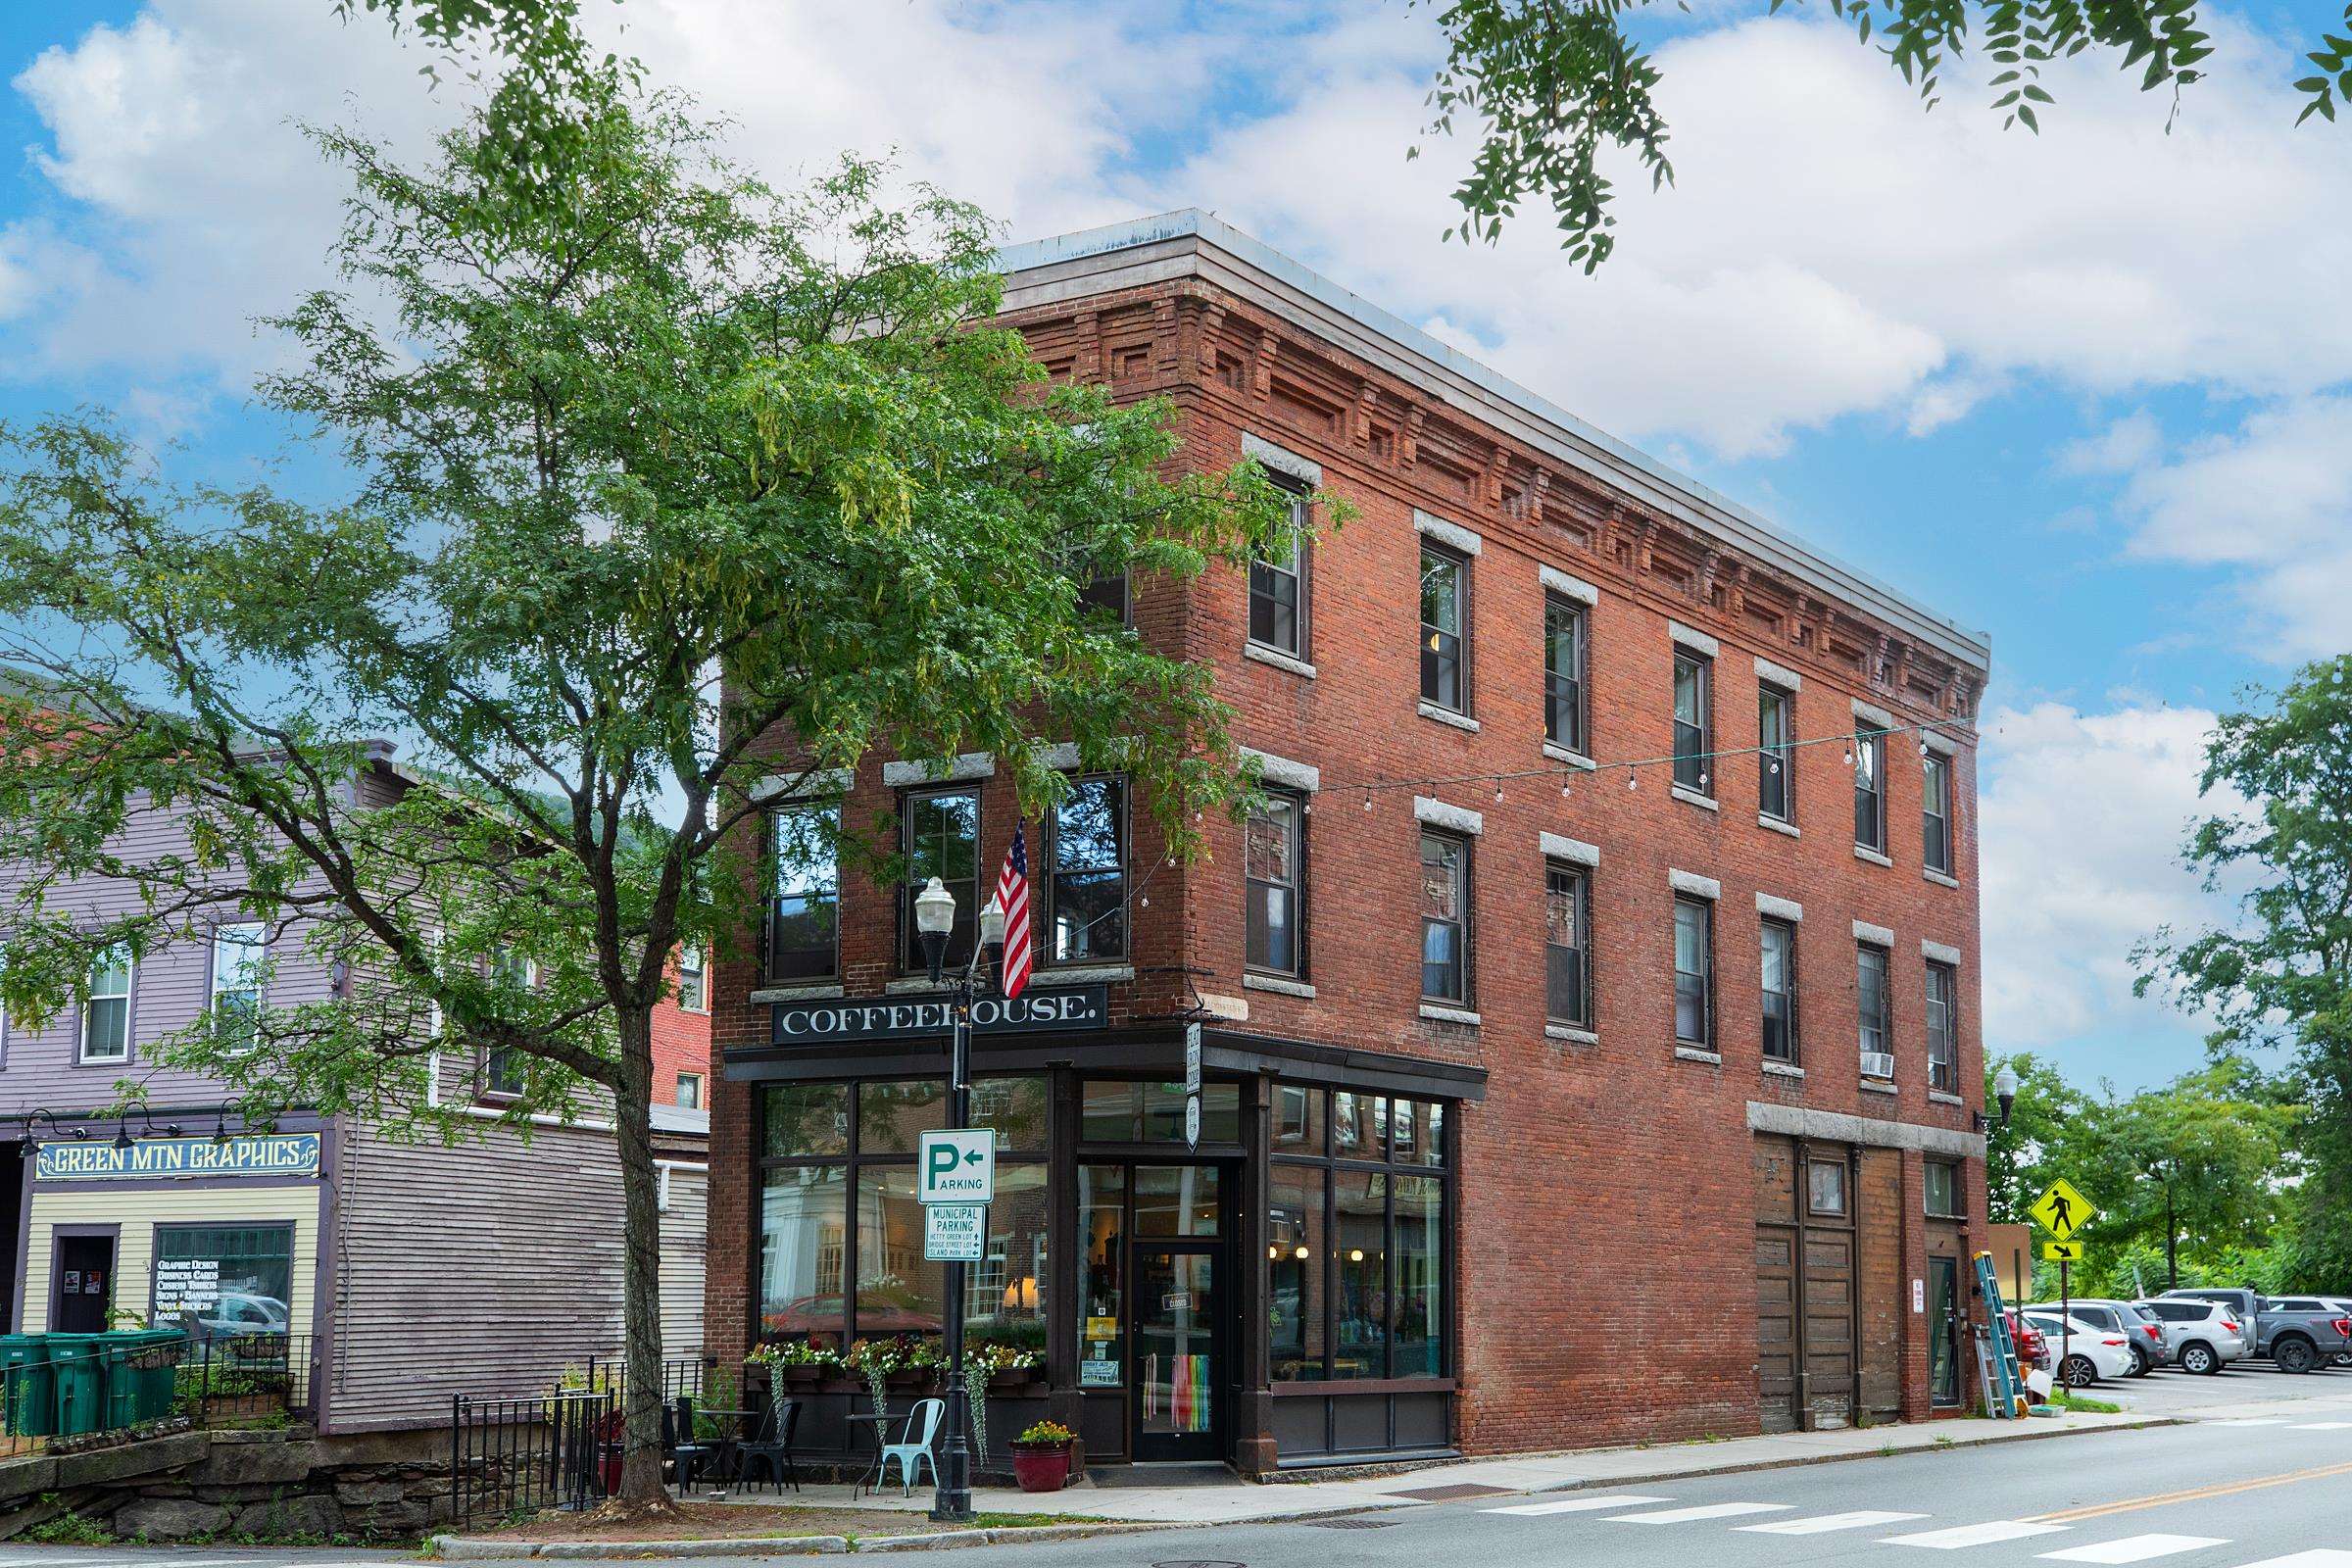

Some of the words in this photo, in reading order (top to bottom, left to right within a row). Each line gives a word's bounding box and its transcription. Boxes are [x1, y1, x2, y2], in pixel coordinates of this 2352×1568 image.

[782, 995, 1097, 1035] COFFEEHOUSE.
[54, 1147, 124, 1172] GREEN
[130, 1145, 182, 1170] MTN
[190, 1141, 300, 1168] GRAPHICS
[933, 1207, 978, 1220] MUNICIPAL
[936, 1220, 974, 1232] PARKING
[191, 1260, 219, 1270] DESIGN
[157, 1271, 192, 1280] BUSINESS
[193, 1270, 219, 1280] CARDS
[157, 1281, 186, 1290] CUSTOM
[156, 1291, 177, 1300] SIGNS
[184, 1291, 219, 1300] BANNERS
[155, 1311, 180, 1321] LOGOS
